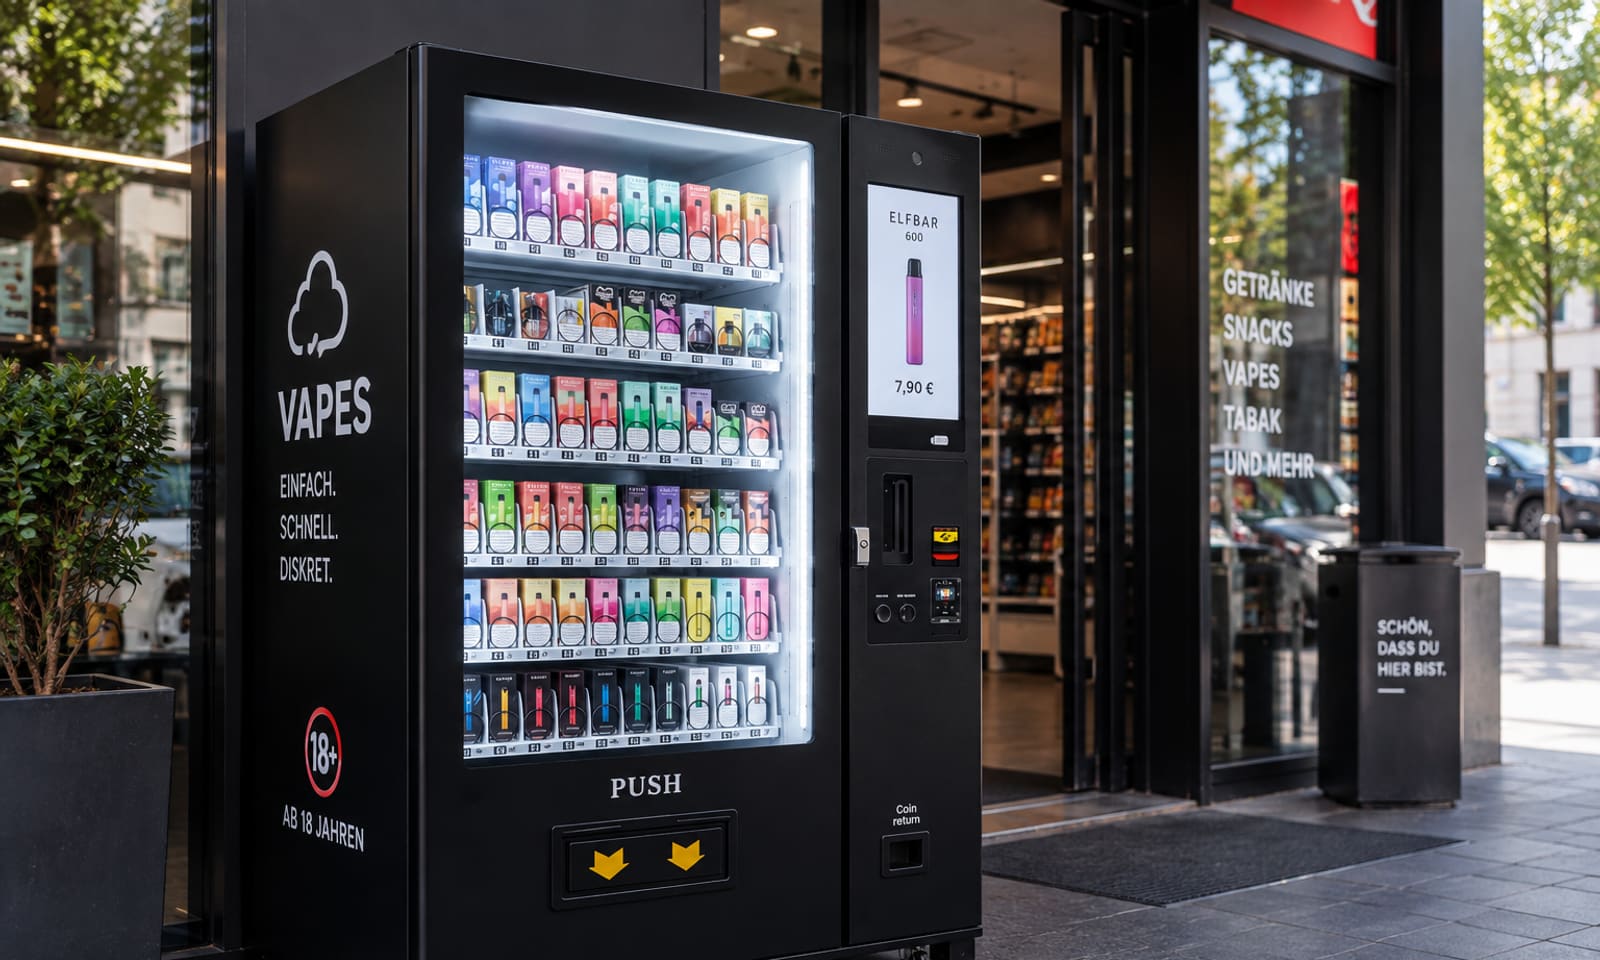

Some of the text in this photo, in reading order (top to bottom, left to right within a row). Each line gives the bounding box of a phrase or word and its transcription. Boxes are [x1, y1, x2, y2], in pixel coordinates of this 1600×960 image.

[889, 210, 938, 229] ELFBAR
[905, 231, 924, 242] 600
[1223, 267, 1315, 307] GETRÄNKE
[1223, 313, 1293, 348] SNACKS
[1223, 358, 1280, 390] VAPES
[895, 380, 935, 396] 7,90 €
[278, 376, 372, 442] VAPES
[1223, 404, 1282, 434] TABAK
[1224, 450, 1314, 479] UND MEHR
[280, 471, 336, 498] EINFACH.
[279, 513, 338, 540] SCHNELL.
[280, 556, 333, 583] DISKRET.
[1377, 616, 1433, 636] SCHÖN,
[1377, 640, 1440, 656] DASS DU
[1377, 661, 1447, 677] HIER BIST.
[310, 731, 337, 775] 18+
[610, 773, 682, 799] PUSH
[892, 815, 921, 826] return
[896, 803, 917, 814] Coin
[282, 805, 364, 852] AB 18 JAHREN
